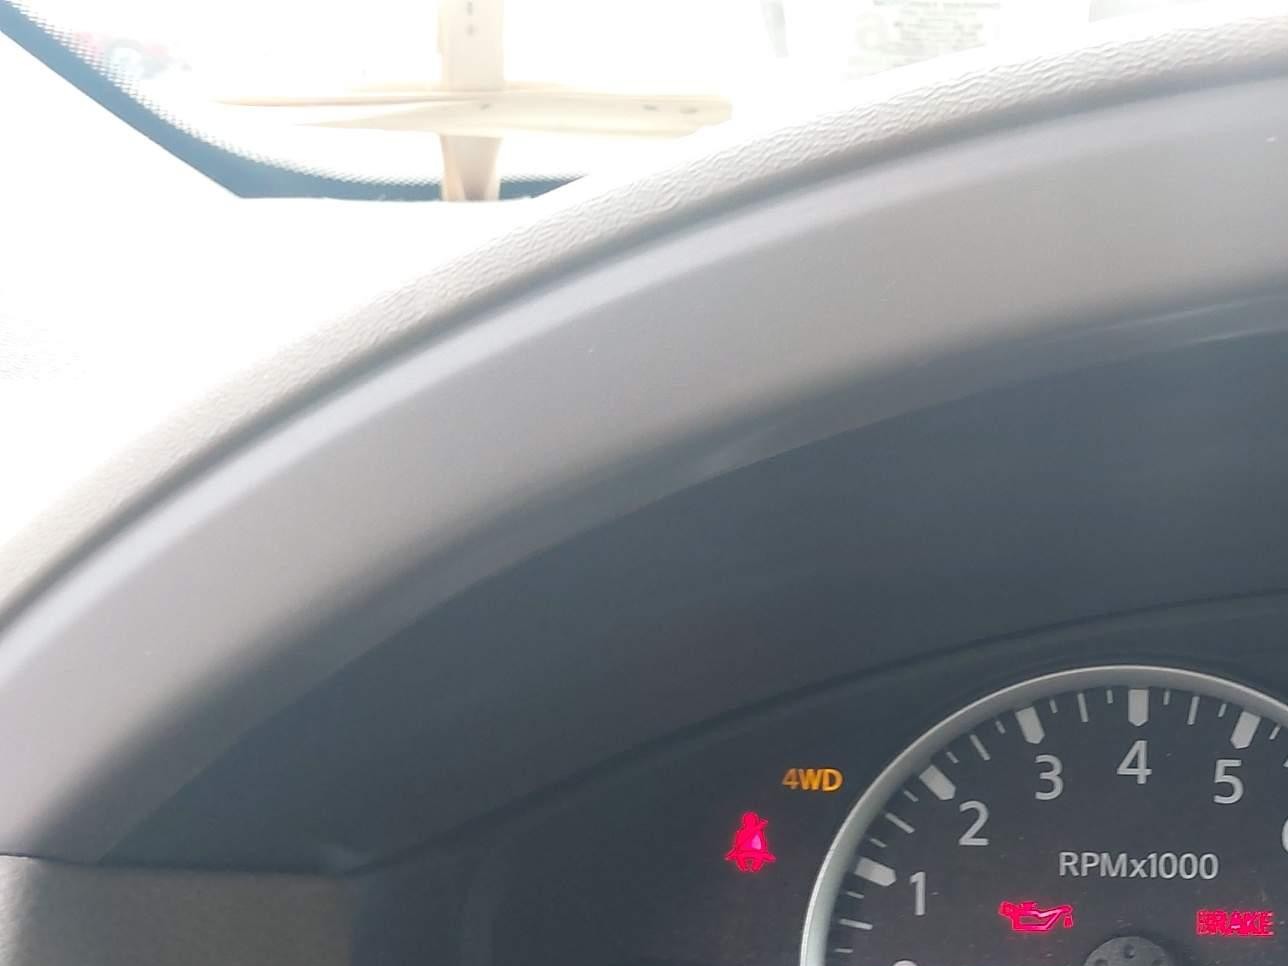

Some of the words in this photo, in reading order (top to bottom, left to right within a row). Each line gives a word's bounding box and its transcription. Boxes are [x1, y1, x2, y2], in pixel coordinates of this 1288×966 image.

[782, 768, 843, 792] 4WD
[1035, 755, 1064, 800] 3
[1117, 740, 1152, 784] 4
[1213, 759, 1243, 803] 5
[959, 802, 989, 846] 2
[1059, 852, 1219, 880] RPMx1000
[910, 873, 928, 915] 1
[1197, 910, 1273, 936] BRAKE
